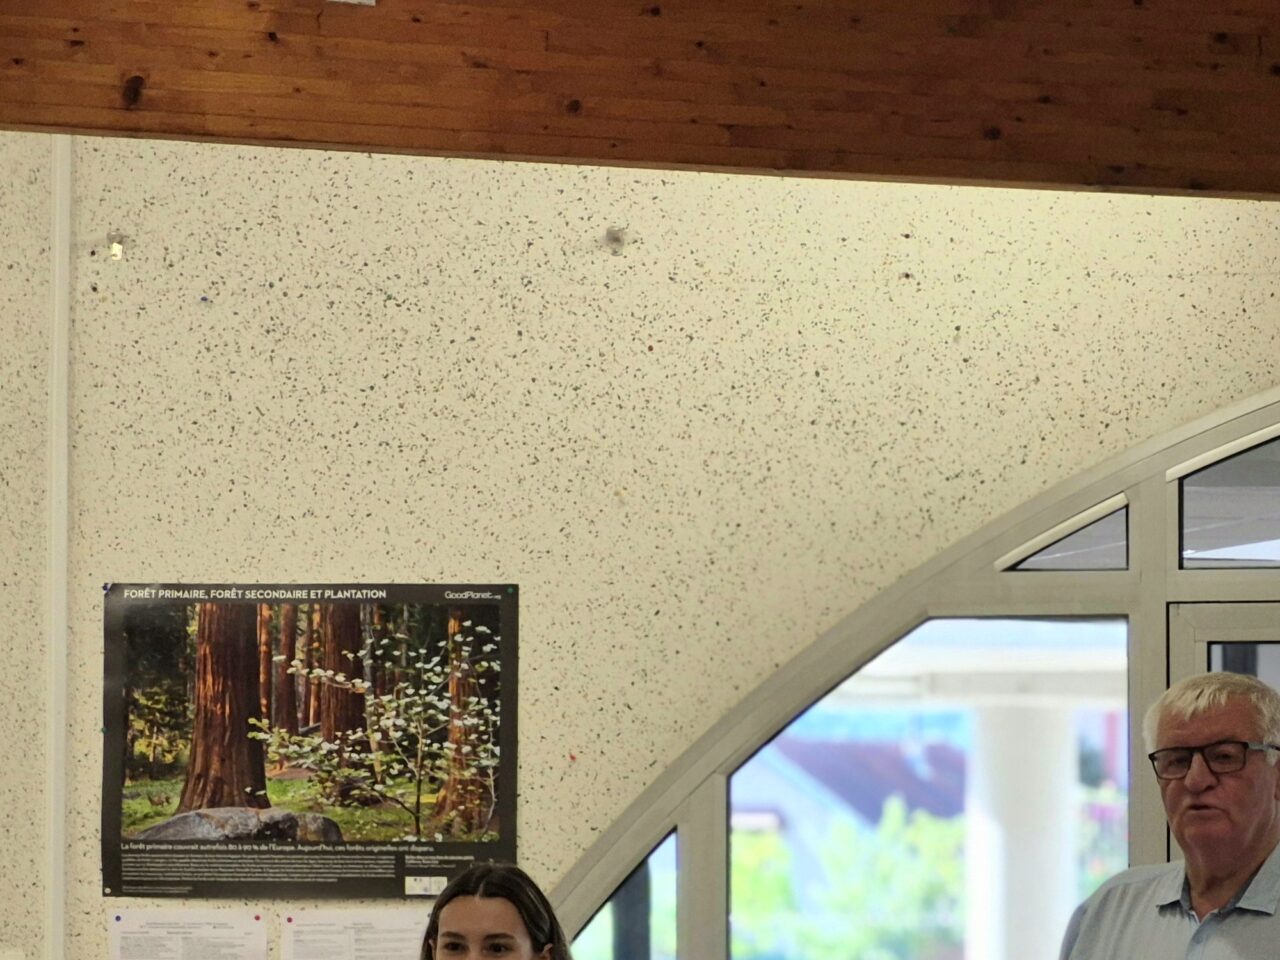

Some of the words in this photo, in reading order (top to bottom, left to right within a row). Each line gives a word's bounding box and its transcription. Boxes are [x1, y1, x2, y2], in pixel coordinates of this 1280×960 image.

[123, 588, 157, 599] FORÊT
[158, 589, 208, 600] PRIMAIRE,
[210, 588, 243, 599] FORÊT
[245, 589, 308, 599] SECONDAIRE
[310, 589, 323, 599] ET
[324, 589, 387, 599] PLANTATION
